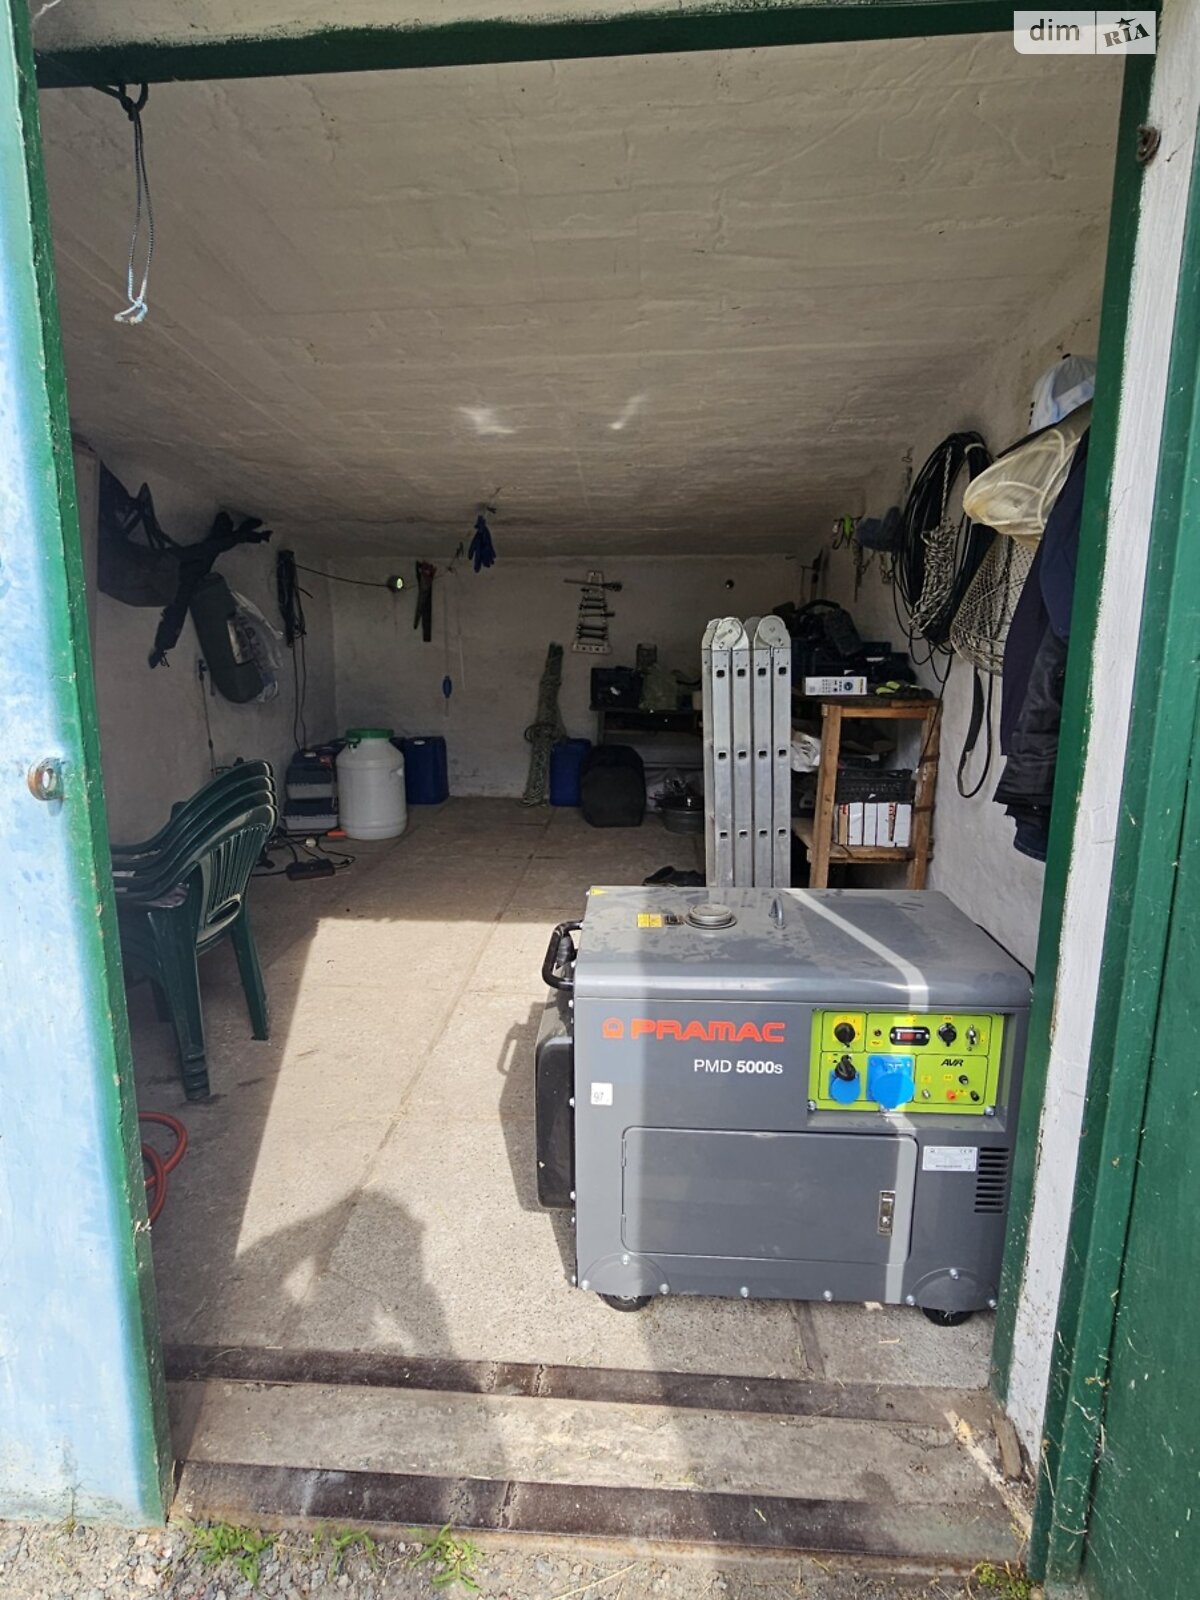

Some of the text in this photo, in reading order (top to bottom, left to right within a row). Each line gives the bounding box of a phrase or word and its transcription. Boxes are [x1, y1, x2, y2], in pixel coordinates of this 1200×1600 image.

[631, 1017, 786, 1043] PRAMAC
[694, 1059, 783, 1075] PMD 5000s
[941, 1059, 964, 1067] AVR
